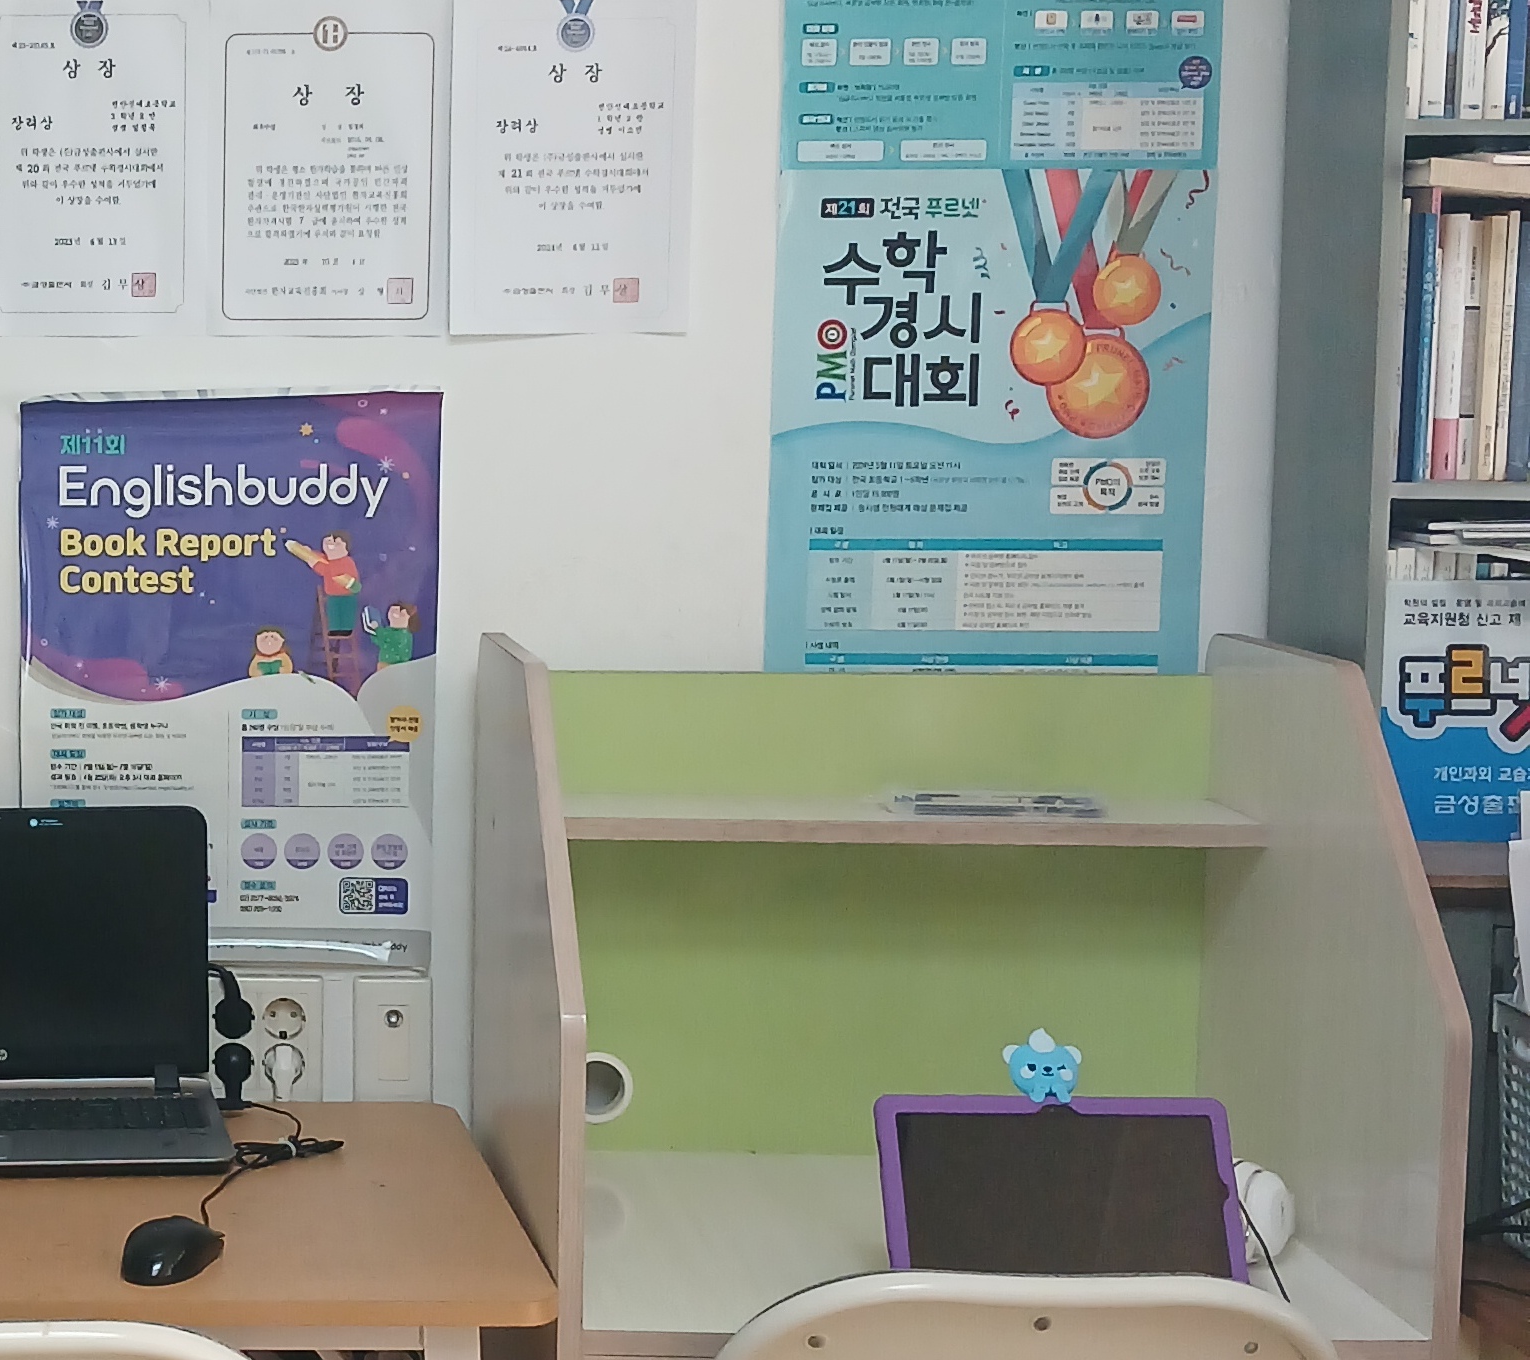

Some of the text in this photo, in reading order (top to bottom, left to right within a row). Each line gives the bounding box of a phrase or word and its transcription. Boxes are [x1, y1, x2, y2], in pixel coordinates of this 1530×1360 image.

[824, 196, 980, 220] 제21회 전국 푸르넷
[822, 230, 947, 305] 수학
[861, 292, 982, 348] 경시
[815, 319, 848, 403] PMO
[863, 353, 980, 408] 대회
[60, 434, 126, 455] 제11회
[58, 462, 389, 518] Englishbuddy
[60, 527, 277, 562] Book Report
[59, 565, 195, 594] Contest
[1404, 612, 1469, 626] 교육지원청
[1477, 613, 1502, 626] 신고
[1434, 766, 1530, 782] 개인과외 교습
